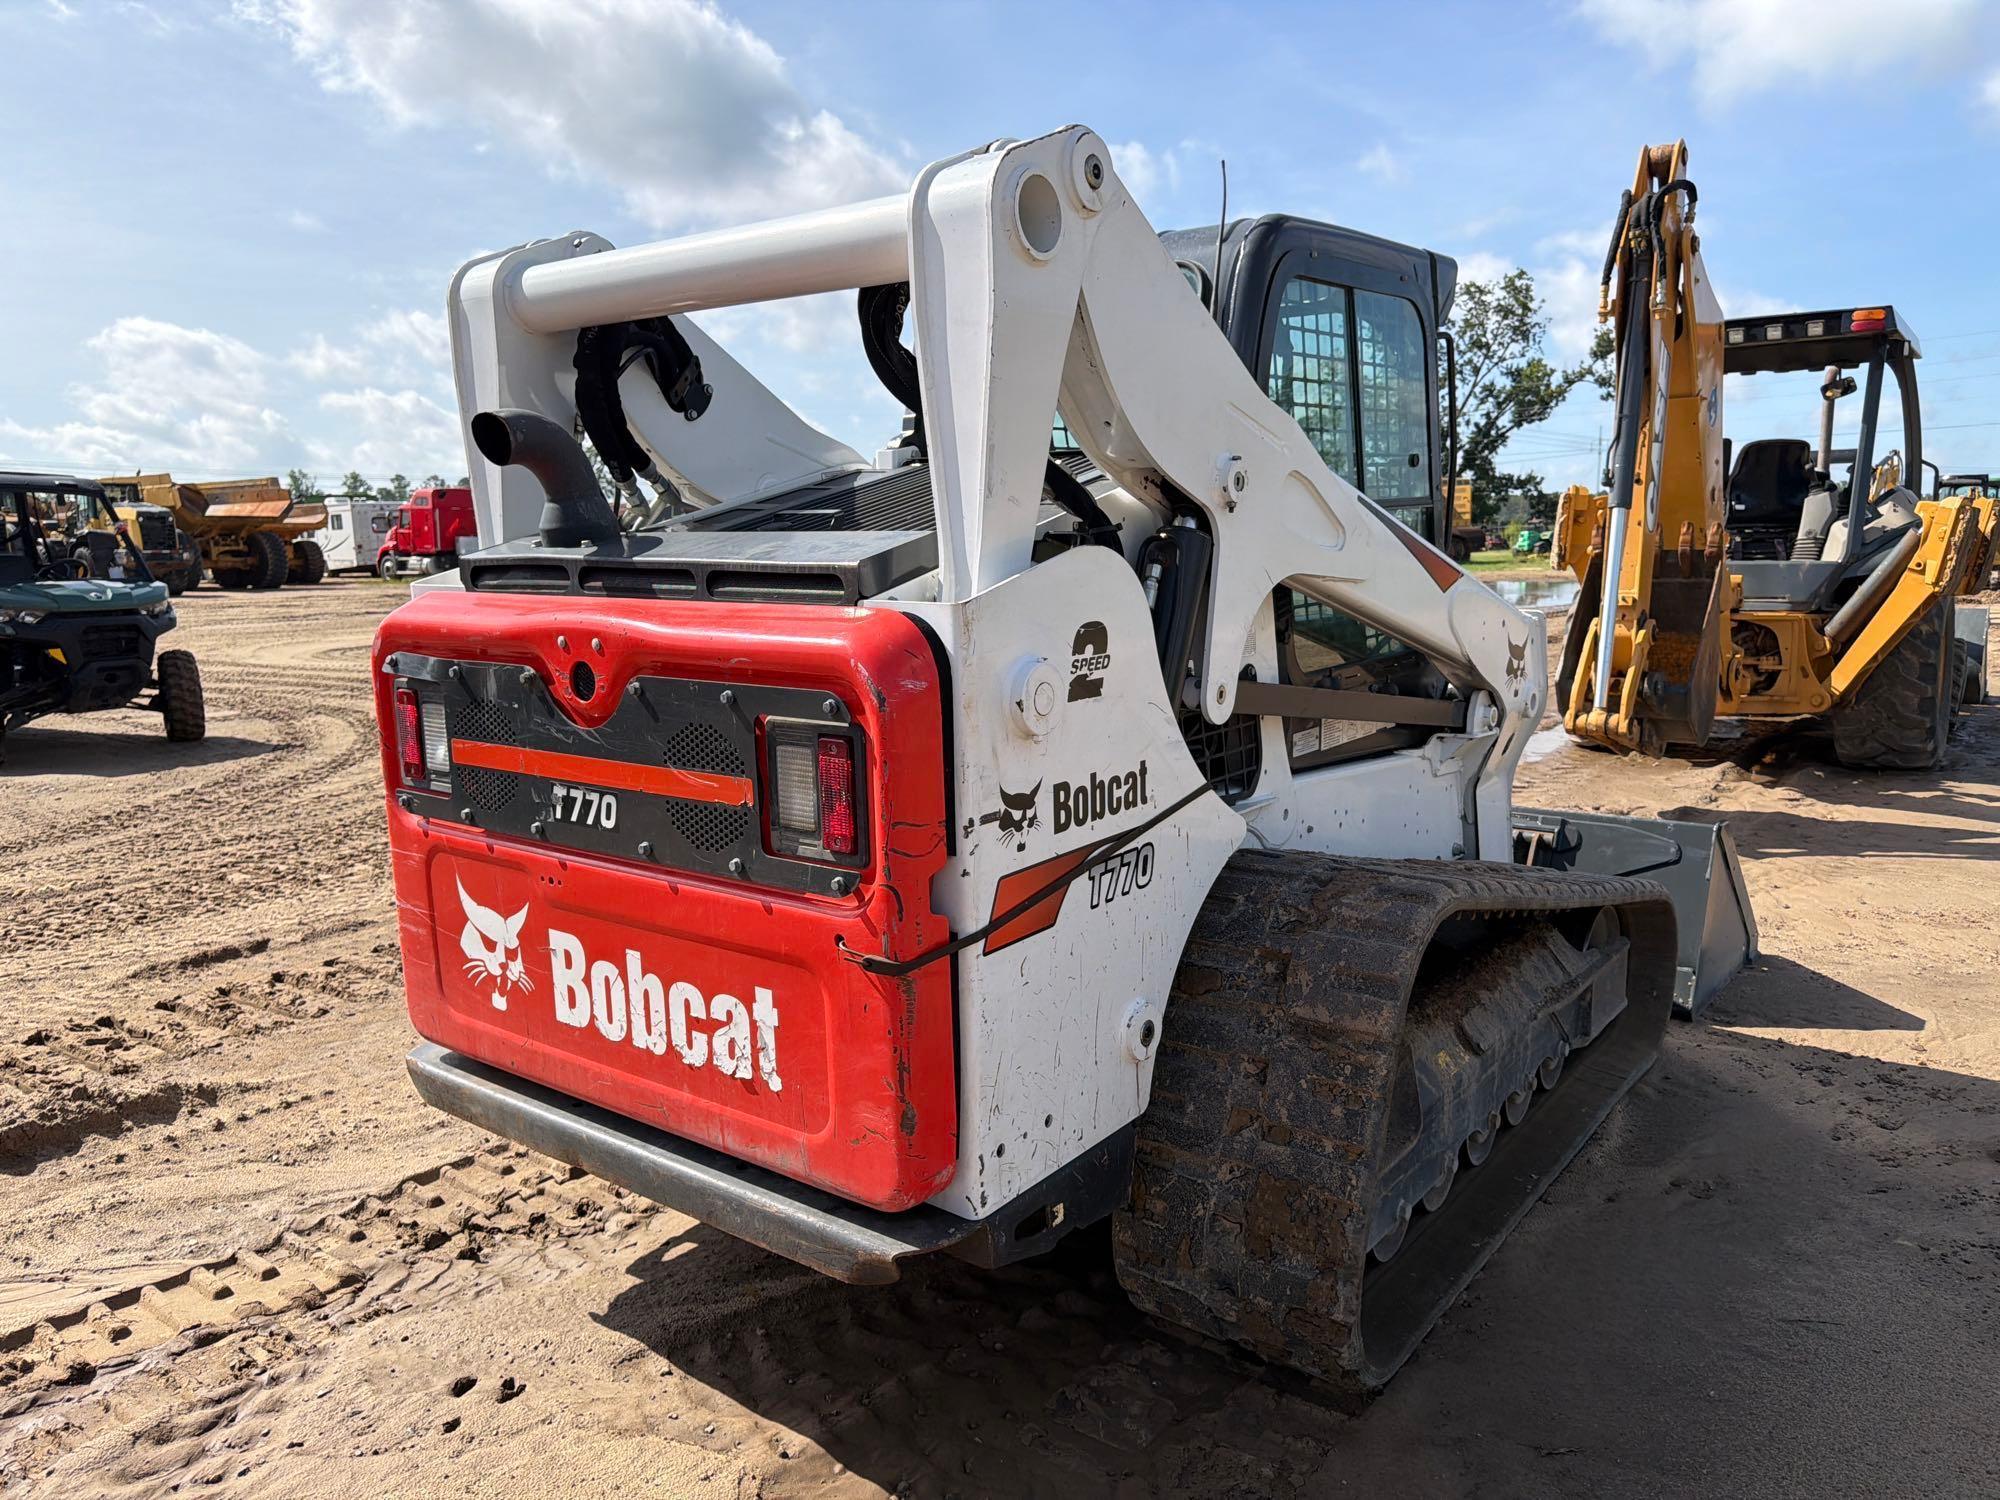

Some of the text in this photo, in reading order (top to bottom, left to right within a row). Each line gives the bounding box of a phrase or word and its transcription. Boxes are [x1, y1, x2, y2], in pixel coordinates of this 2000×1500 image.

[1070, 654, 1111, 674] SPEED
[552, 785, 617, 829] T770
[1053, 760, 1148, 835] Bobcat
[1088, 842, 1154, 910] T770
[548, 928, 783, 1093] Bobcat
